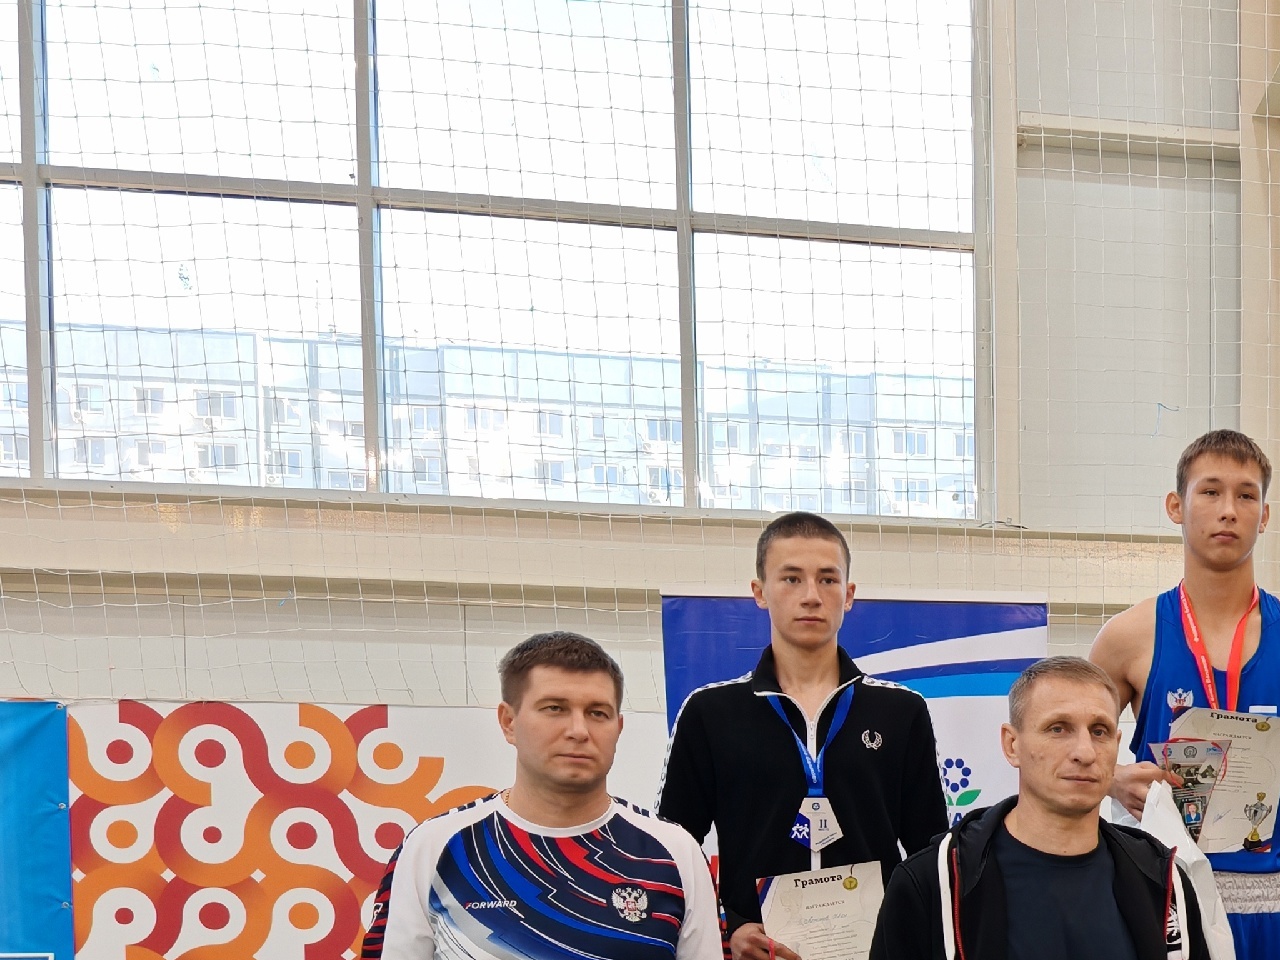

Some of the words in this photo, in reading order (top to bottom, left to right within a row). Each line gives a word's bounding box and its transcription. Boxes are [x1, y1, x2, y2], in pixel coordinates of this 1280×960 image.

[1210, 711, 1258, 723] Грамота
[794, 874, 843, 889] Грамота
[464, 899, 517, 910] FORWARD
